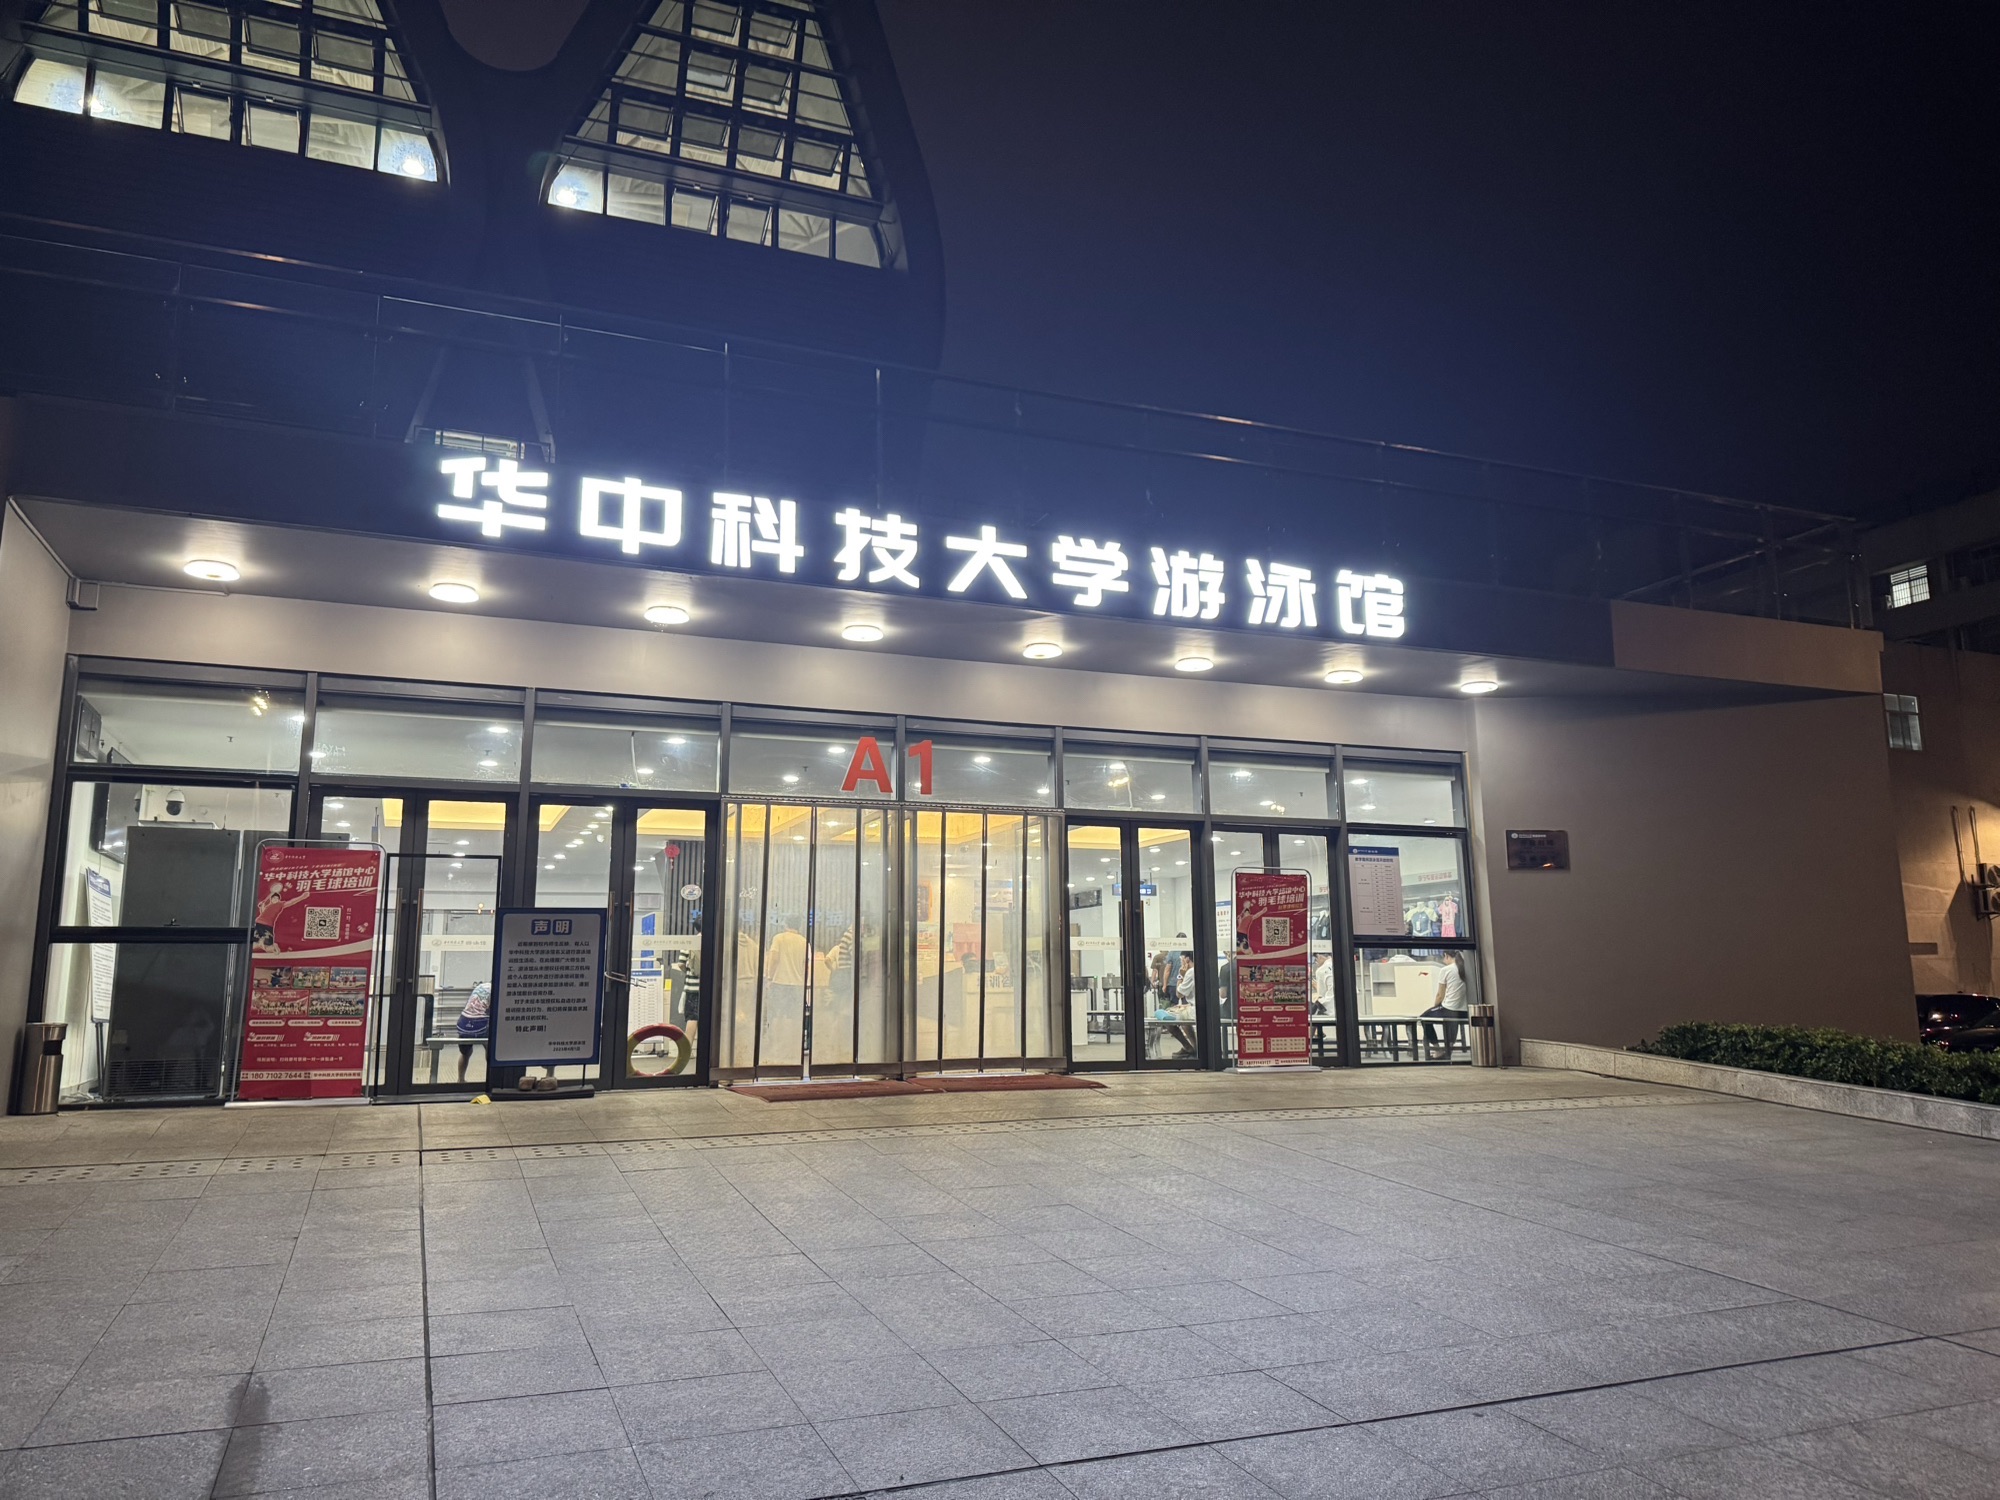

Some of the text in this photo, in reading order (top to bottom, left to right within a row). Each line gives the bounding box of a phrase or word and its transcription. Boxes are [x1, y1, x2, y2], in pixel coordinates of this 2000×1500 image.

[437, 456, 1406, 640] 华中科技大学游泳馆
[841, 736, 933, 796] A1
[264, 866, 376, 881] 华中科技大学场馆中心
[296, 876, 373, 892] 羽毛球培训
[1238, 886, 1306, 899] 华中科技大学场馆中心
[1258, 893, 1305, 907] 羽毛球培训
[533, 920, 570, 934] 声明
[284, 1071, 302, 1079] 7644
